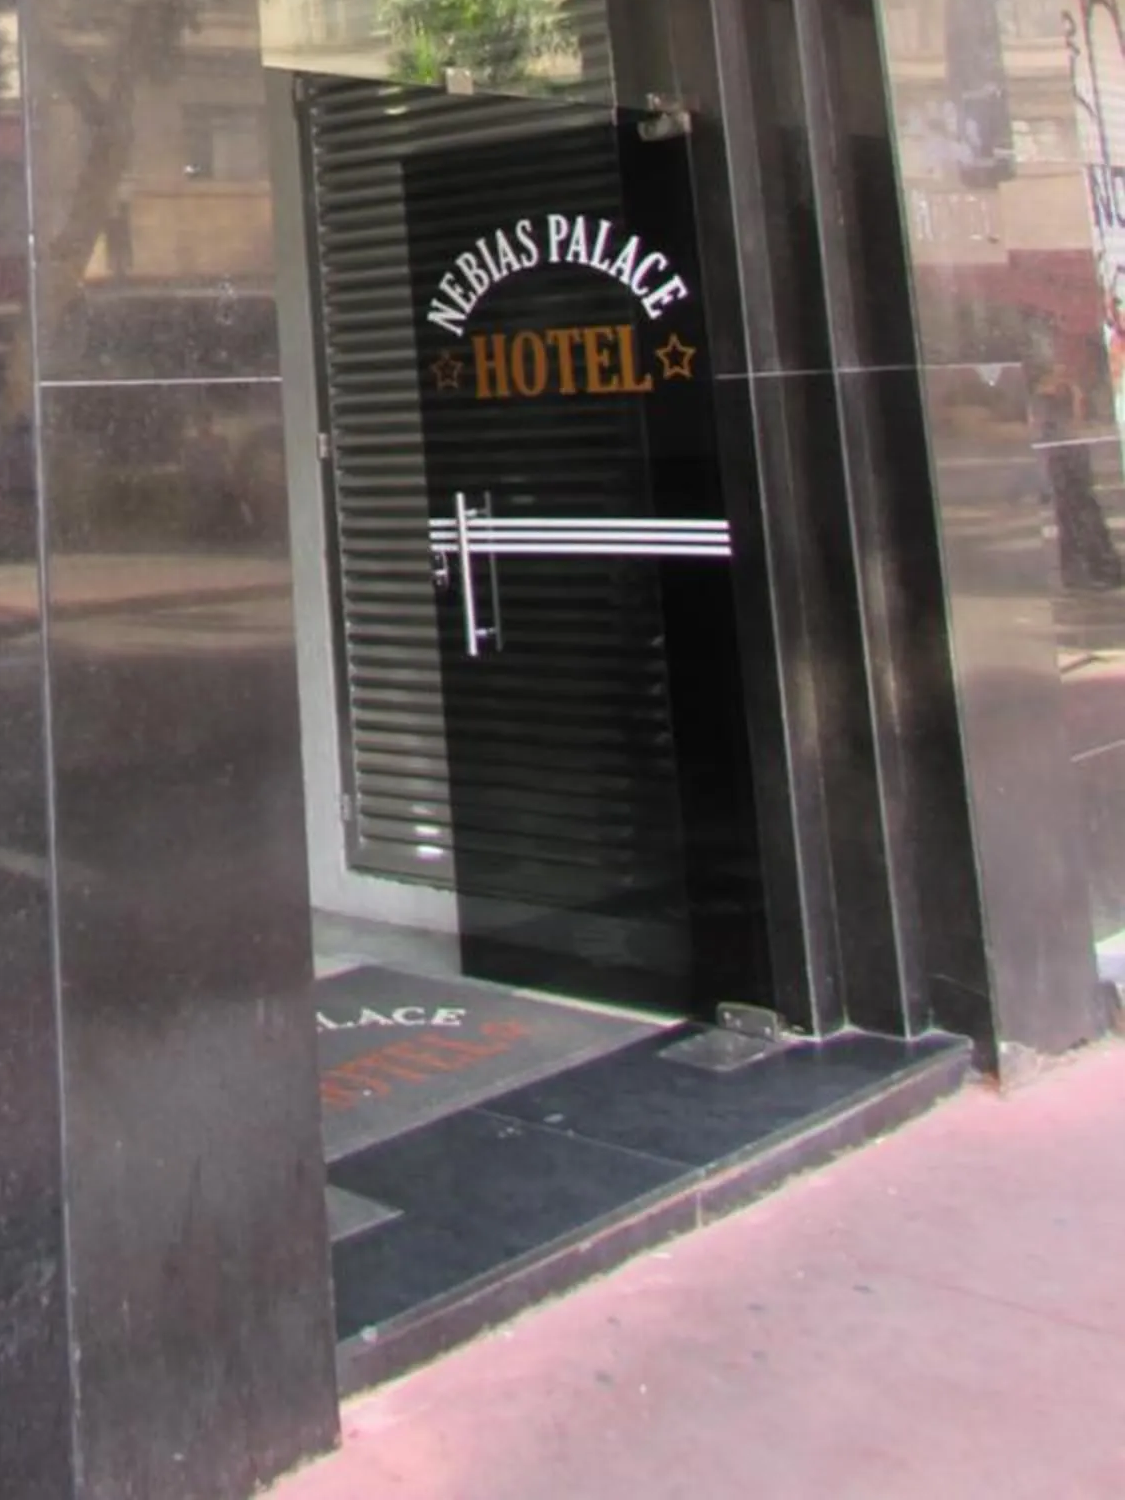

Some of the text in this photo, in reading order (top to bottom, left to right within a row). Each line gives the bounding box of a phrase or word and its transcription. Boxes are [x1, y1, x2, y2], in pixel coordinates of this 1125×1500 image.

[426, 213, 689, 337] NEBIAS PALACE
[471, 323, 654, 399] HOTEL
[316, 1006, 467, 1031] LACE
